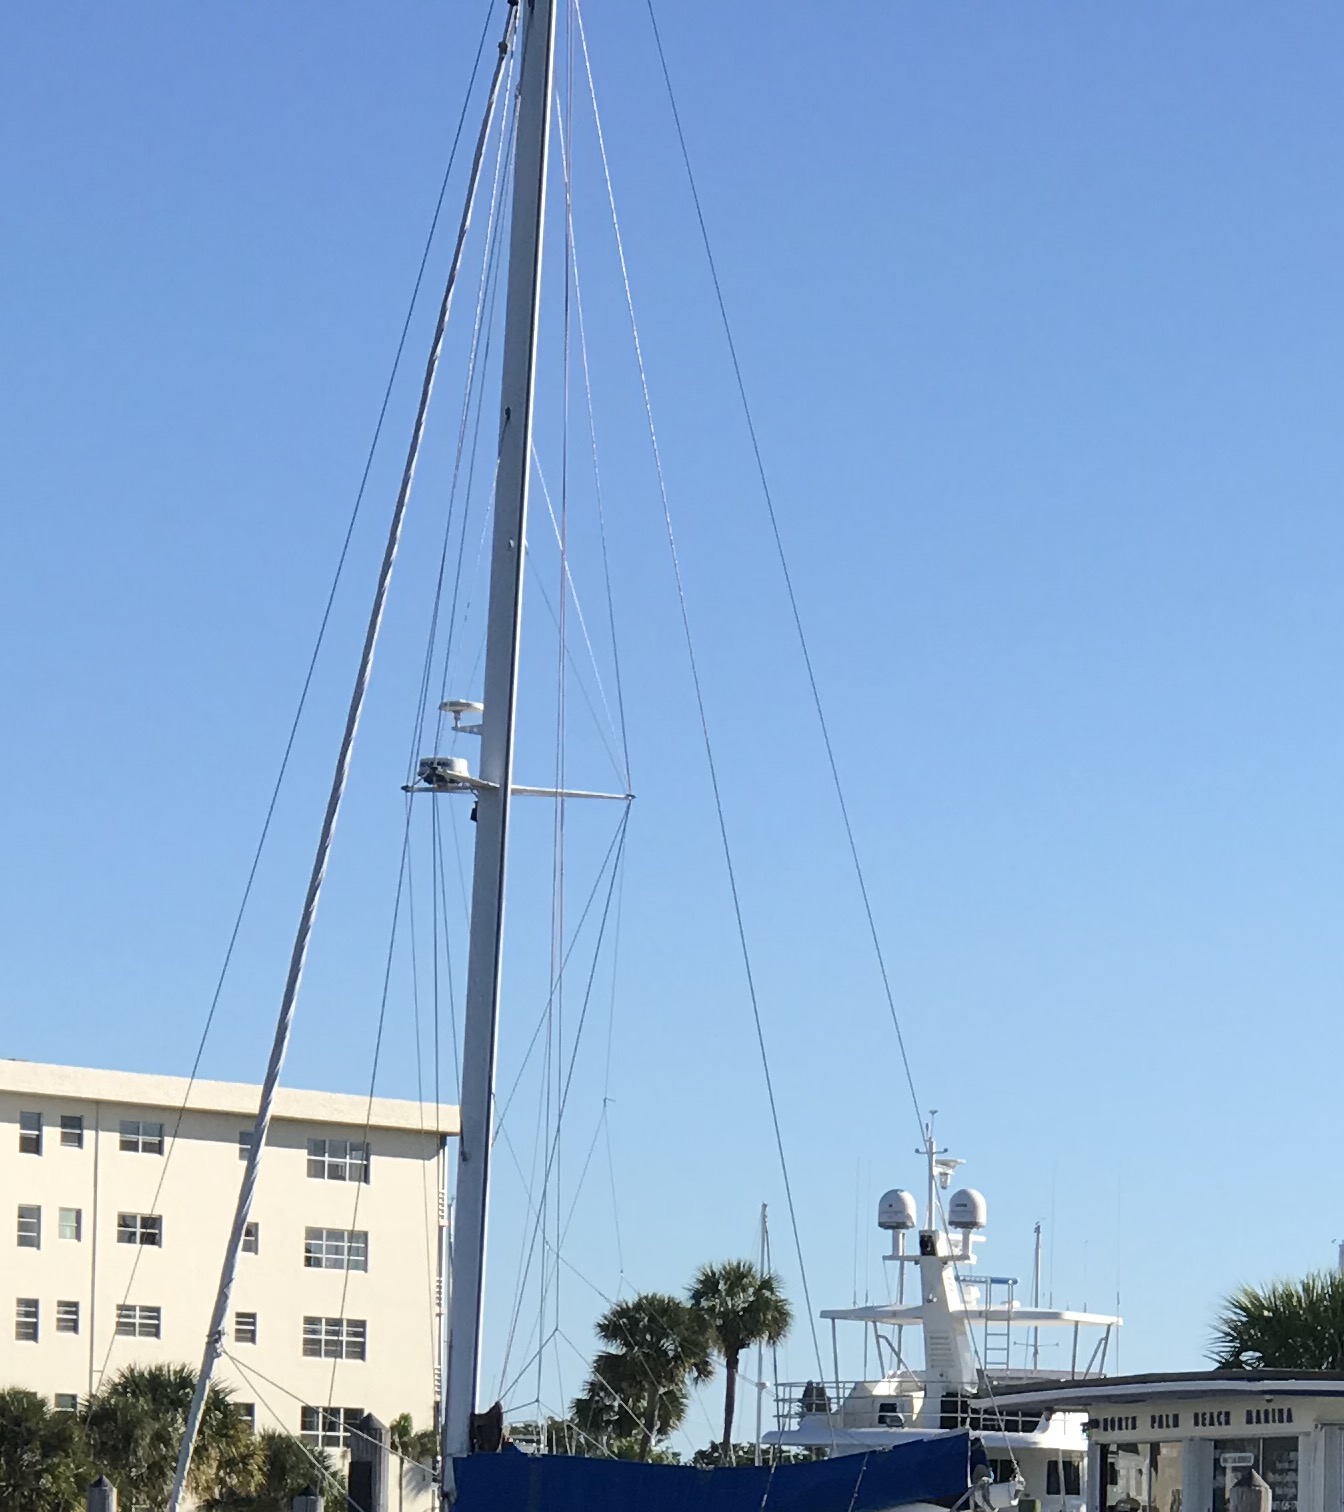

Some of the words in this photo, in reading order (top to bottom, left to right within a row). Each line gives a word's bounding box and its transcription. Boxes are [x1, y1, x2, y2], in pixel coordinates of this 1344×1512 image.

[1103, 1416, 1137, 1432] NORTH
[1150, 1413, 1179, 1429] PALM
[1193, 1410, 1231, 1427] BEACH
[1246, 1408, 1293, 1424] MARINA
